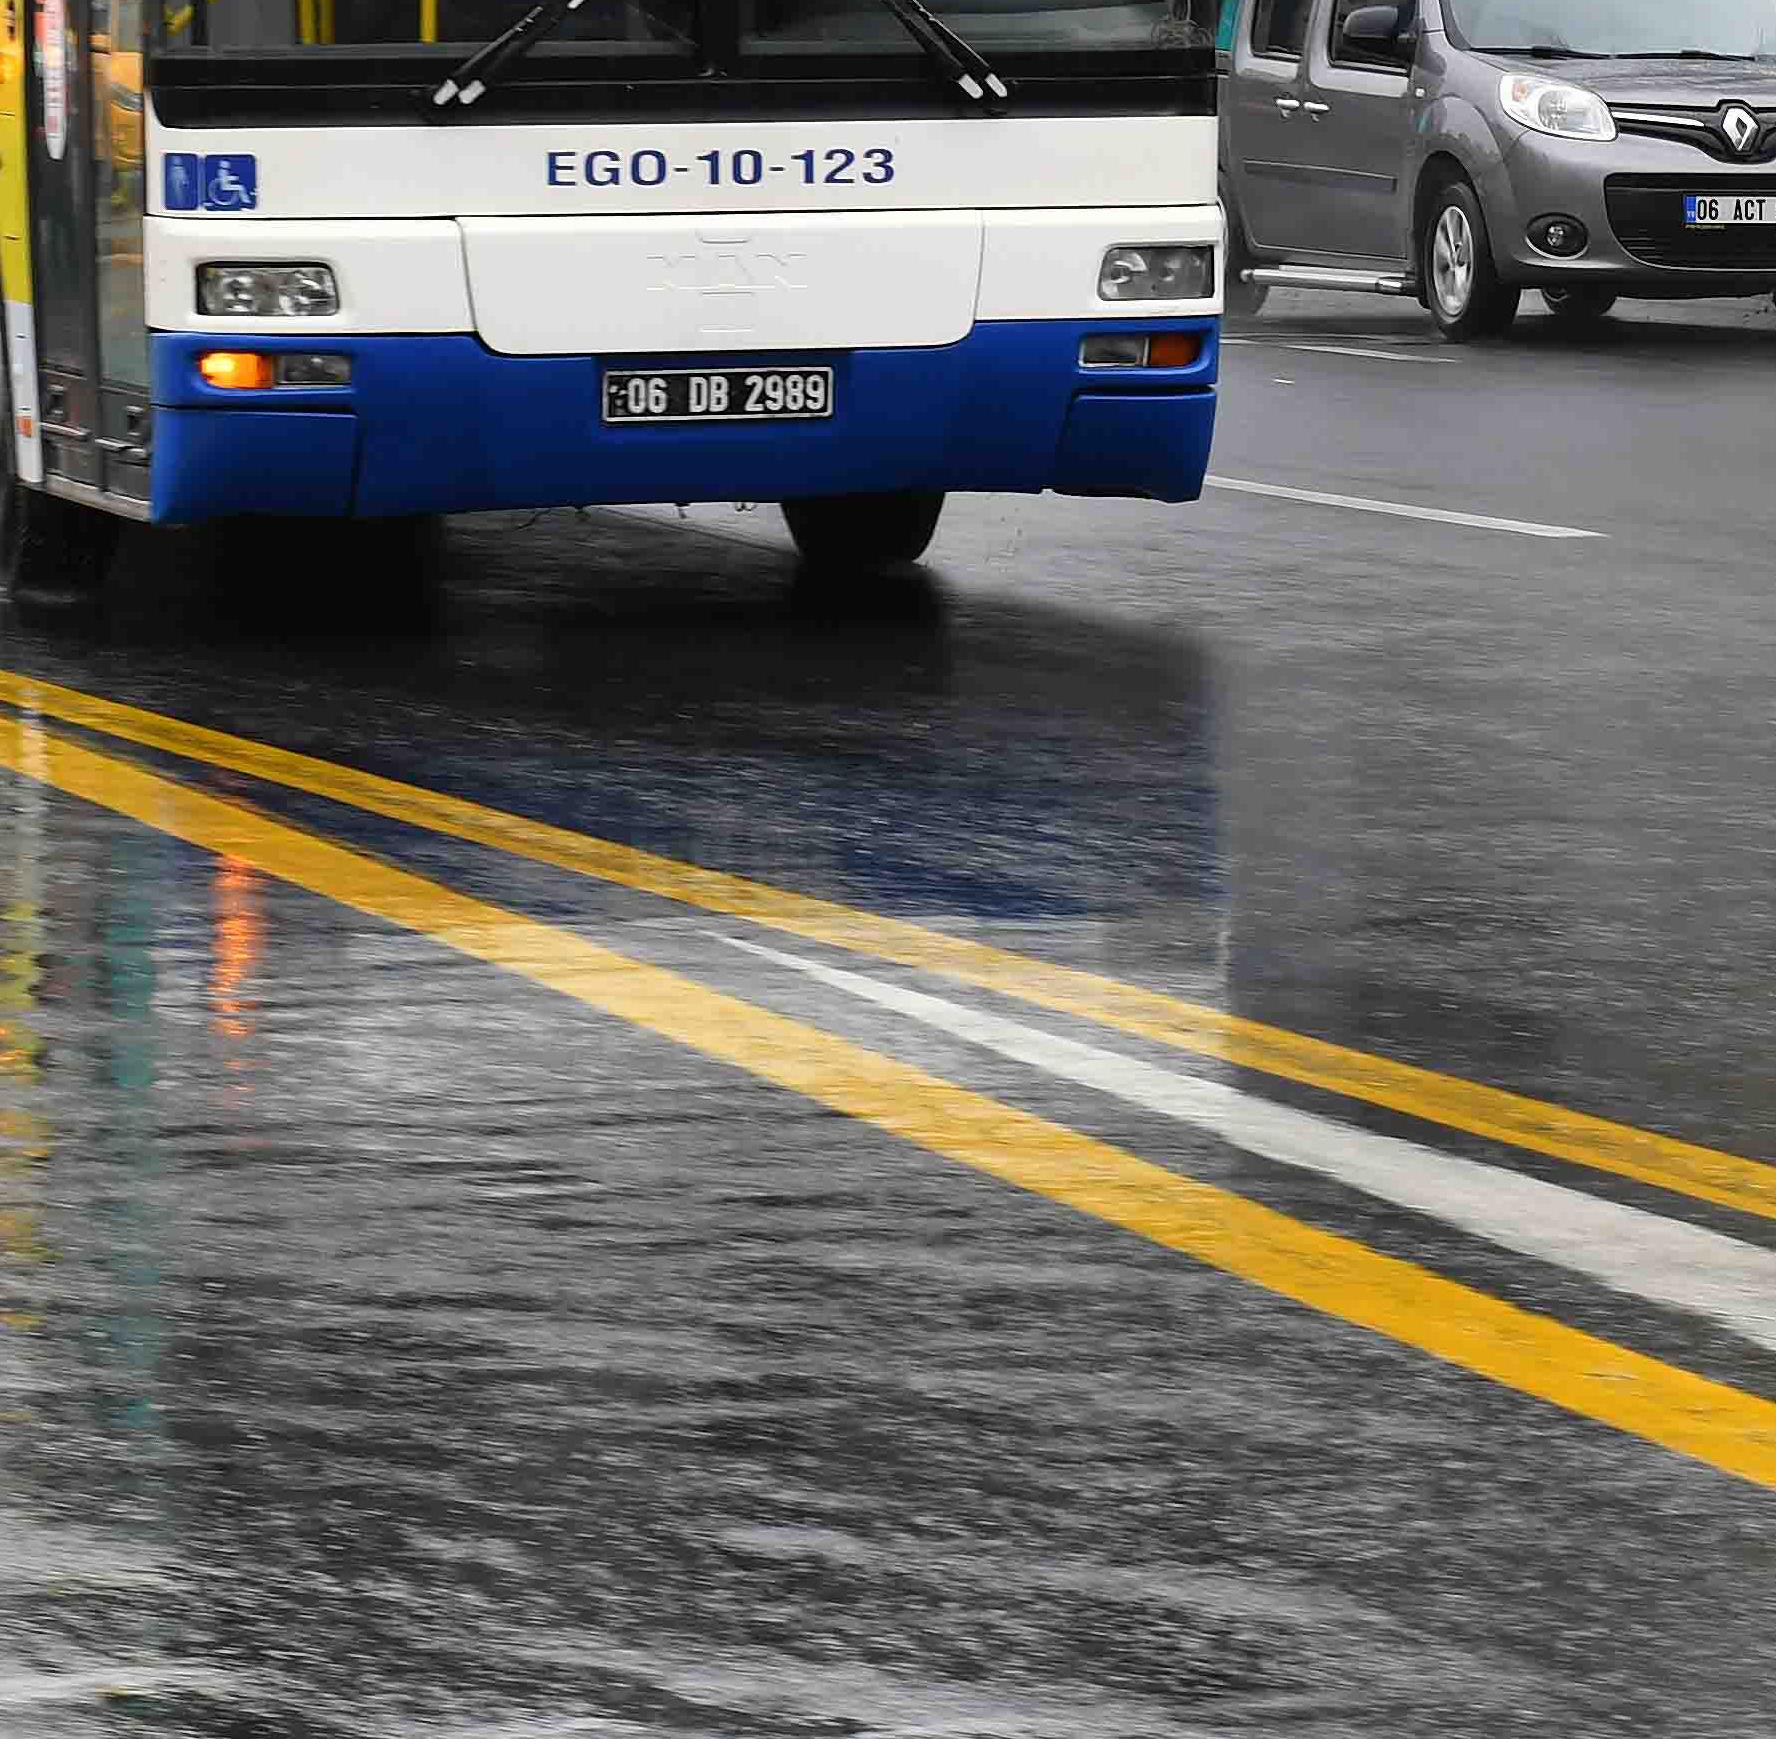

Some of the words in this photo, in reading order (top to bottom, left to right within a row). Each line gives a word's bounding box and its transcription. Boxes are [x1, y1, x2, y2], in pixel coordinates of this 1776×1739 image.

[547, 148, 896, 186] EGO-10-123
[1697, 199, 1719, 221] 06
[1734, 199, 1766, 221] ACT
[627, 377, 668, 414] 06
[688, 376, 729, 412] DB
[744, 375, 826, 411] 2989
